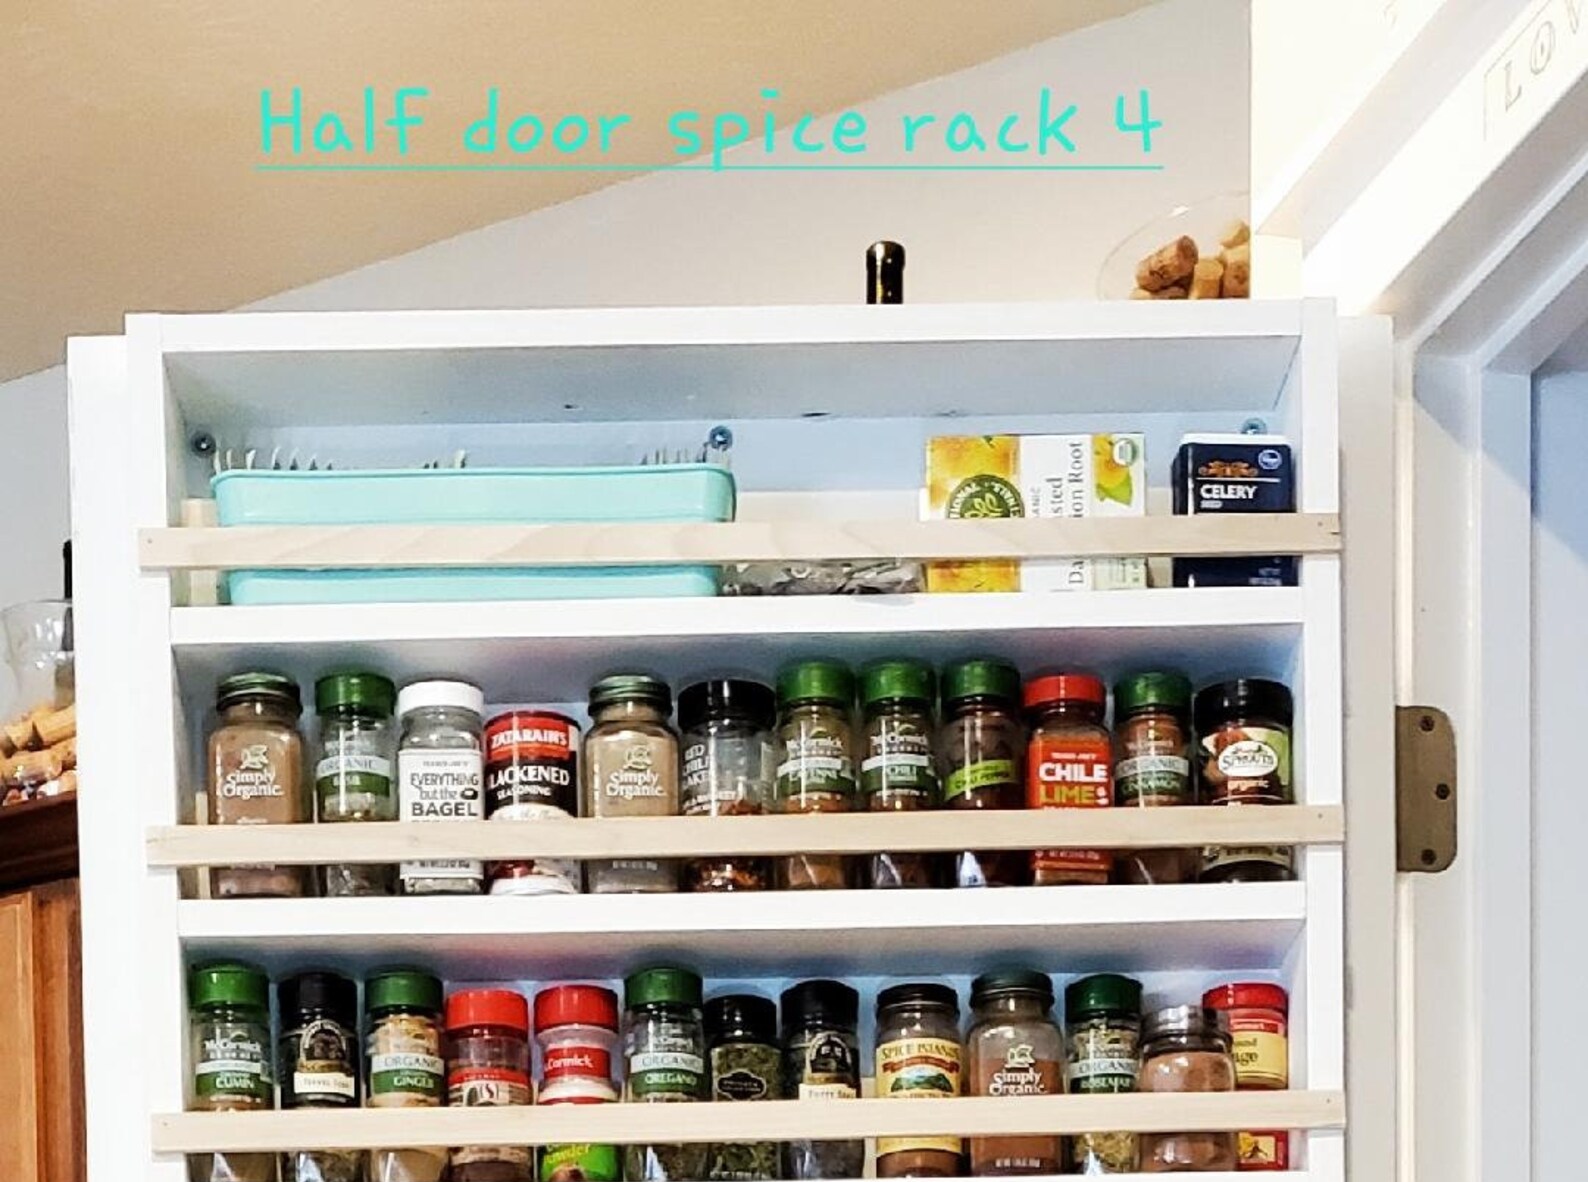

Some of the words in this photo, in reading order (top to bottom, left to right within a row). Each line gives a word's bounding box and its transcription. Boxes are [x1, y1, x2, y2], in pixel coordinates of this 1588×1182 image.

[1068, 442, 1084, 485] Root
[1046, 477, 1063, 518] sted
[1200, 484, 1257, 500] CELERY
[491, 729, 568, 748] ZATARAIN'S
[410, 772, 479, 786] EVERYTHING
[489, 766, 570, 789] LACKENED
[1039, 763, 1108, 782] CHILE
[222, 783, 280, 799] Organic
[420, 787, 438, 801] but
[440, 787, 458, 801] the
[606, 783, 664, 799] Organic
[1039, 785, 1095, 804] LIME
[411, 802, 479, 817] BAGEL
[881, 1044, 913, 1060] SPICE
[1233, 1050, 1258, 1065] age
[546, 1053, 594, 1070] Cormick
[215, 1076, 254, 1089] CUMIN
[989, 1082, 1045, 1096] Organic
